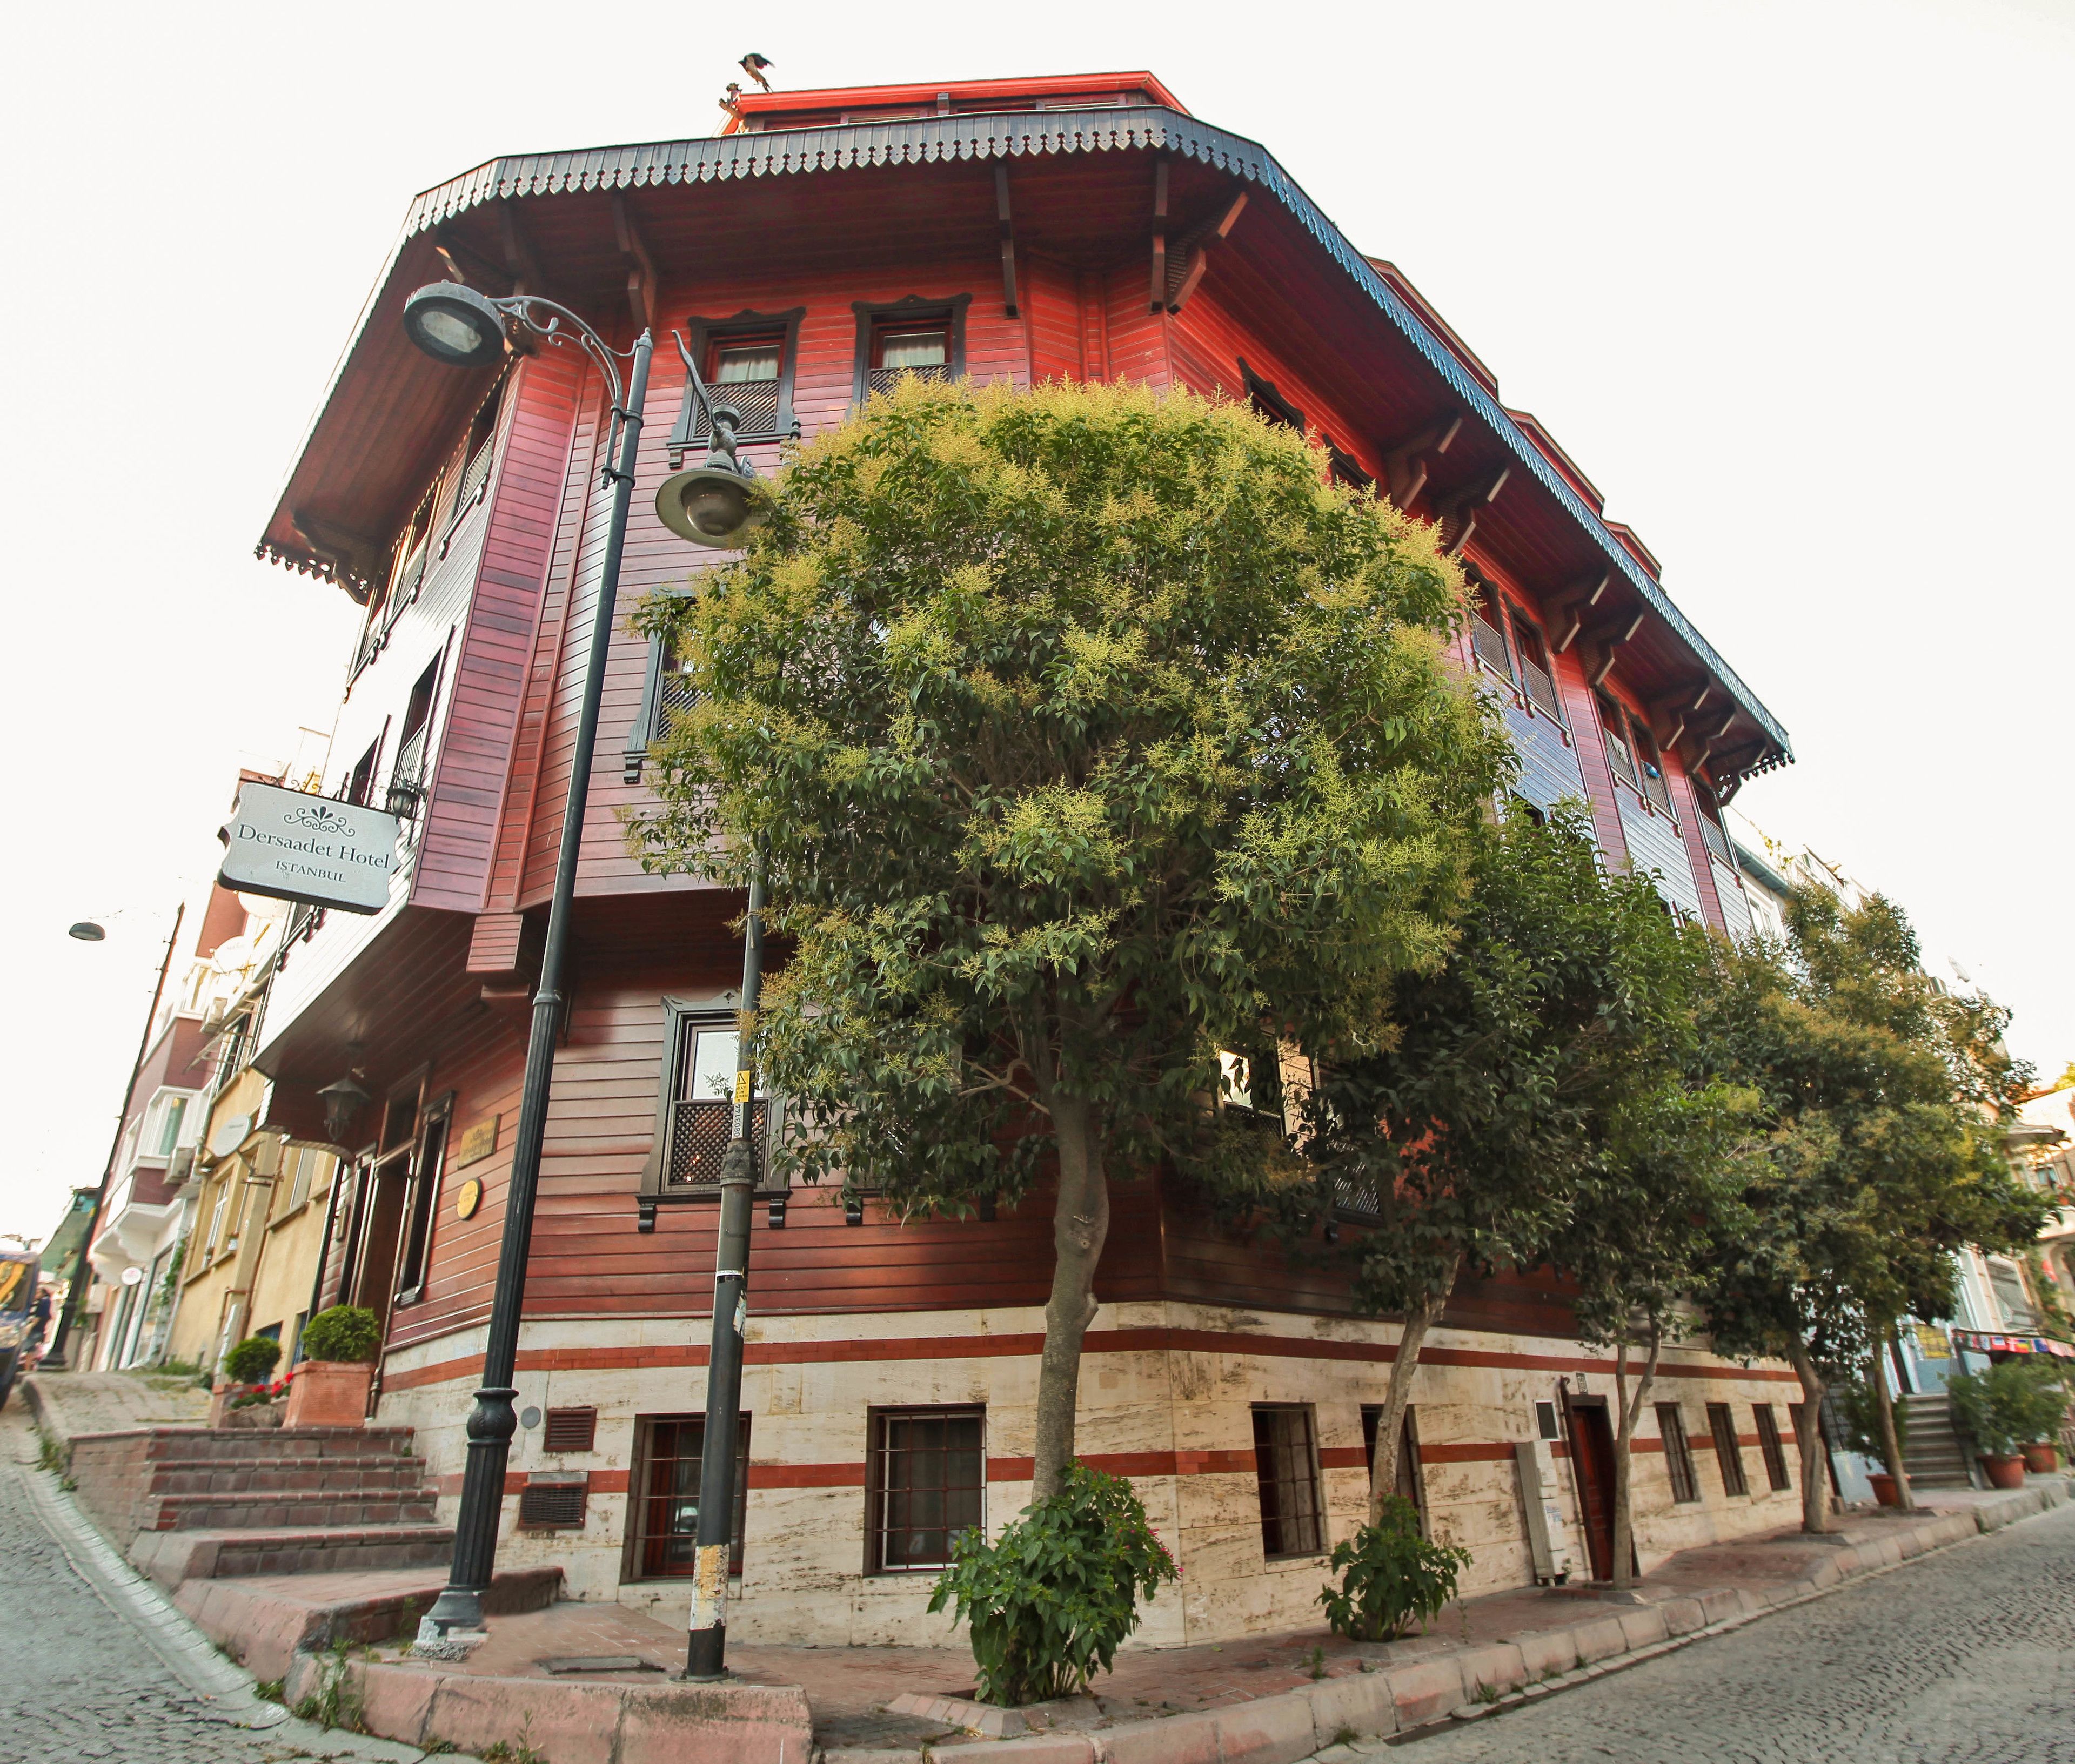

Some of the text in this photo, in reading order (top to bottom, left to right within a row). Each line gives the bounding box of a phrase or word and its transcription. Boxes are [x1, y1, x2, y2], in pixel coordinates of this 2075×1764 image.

[238, 824, 389, 869] Dersaadet Hotel
[275, 861, 346, 883] ISTANBUL
